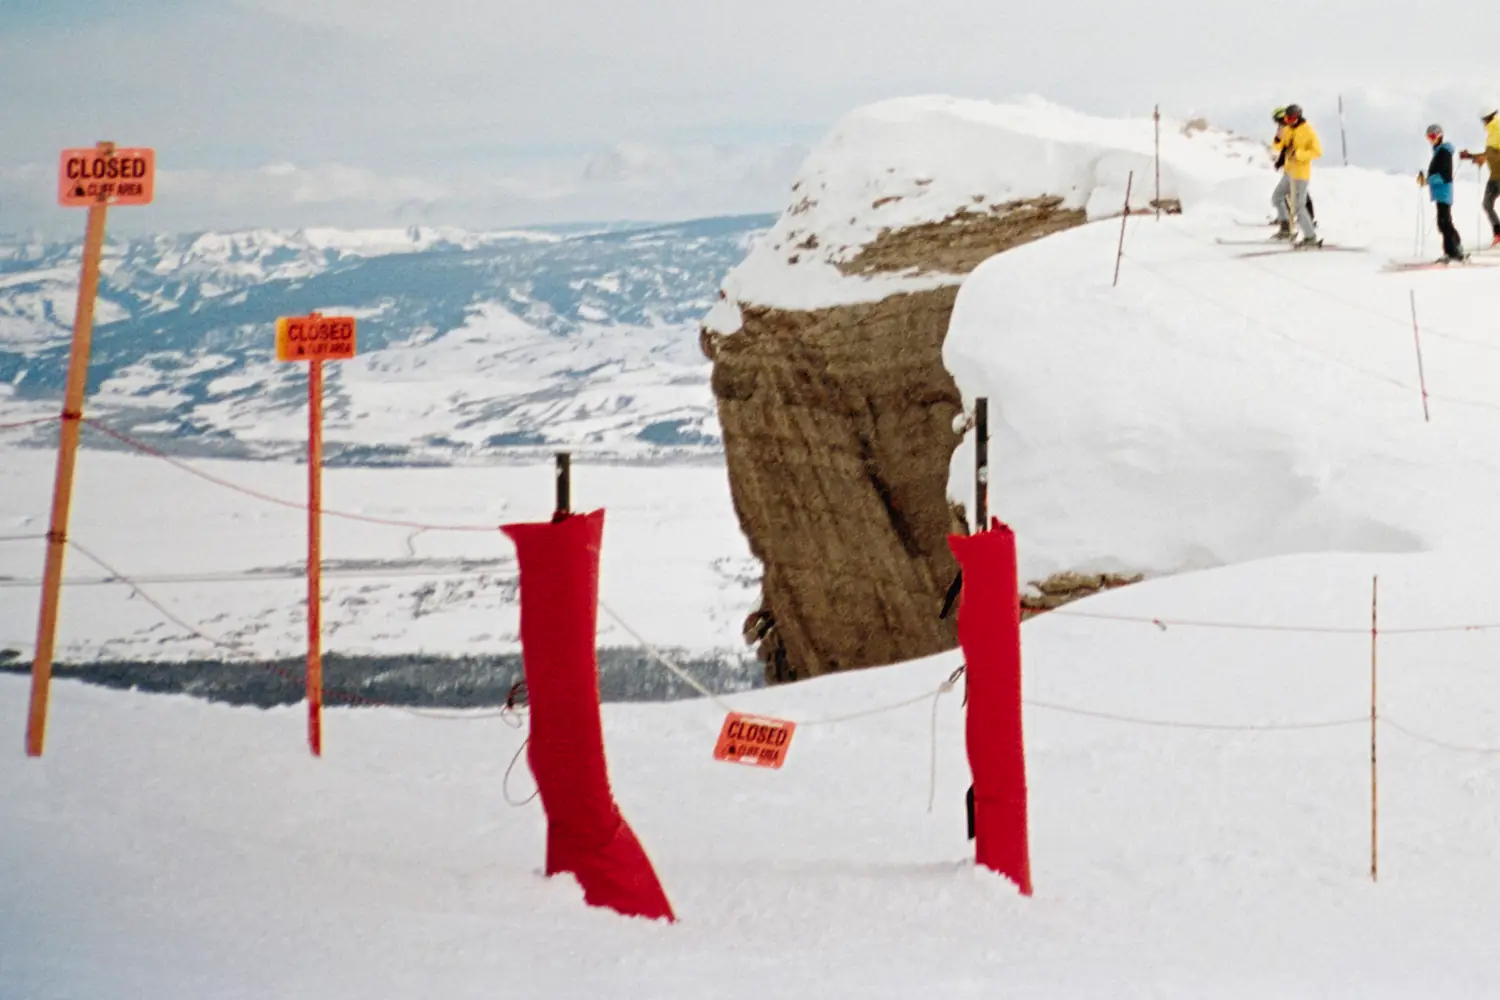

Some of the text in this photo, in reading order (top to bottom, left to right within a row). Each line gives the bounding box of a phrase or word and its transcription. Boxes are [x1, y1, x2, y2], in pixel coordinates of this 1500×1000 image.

[66, 157, 146, 179] CLOSED
[117, 183, 143, 196] AREA
[288, 323, 353, 341] CLOSED
[727, 720, 788, 747] CLOSED
